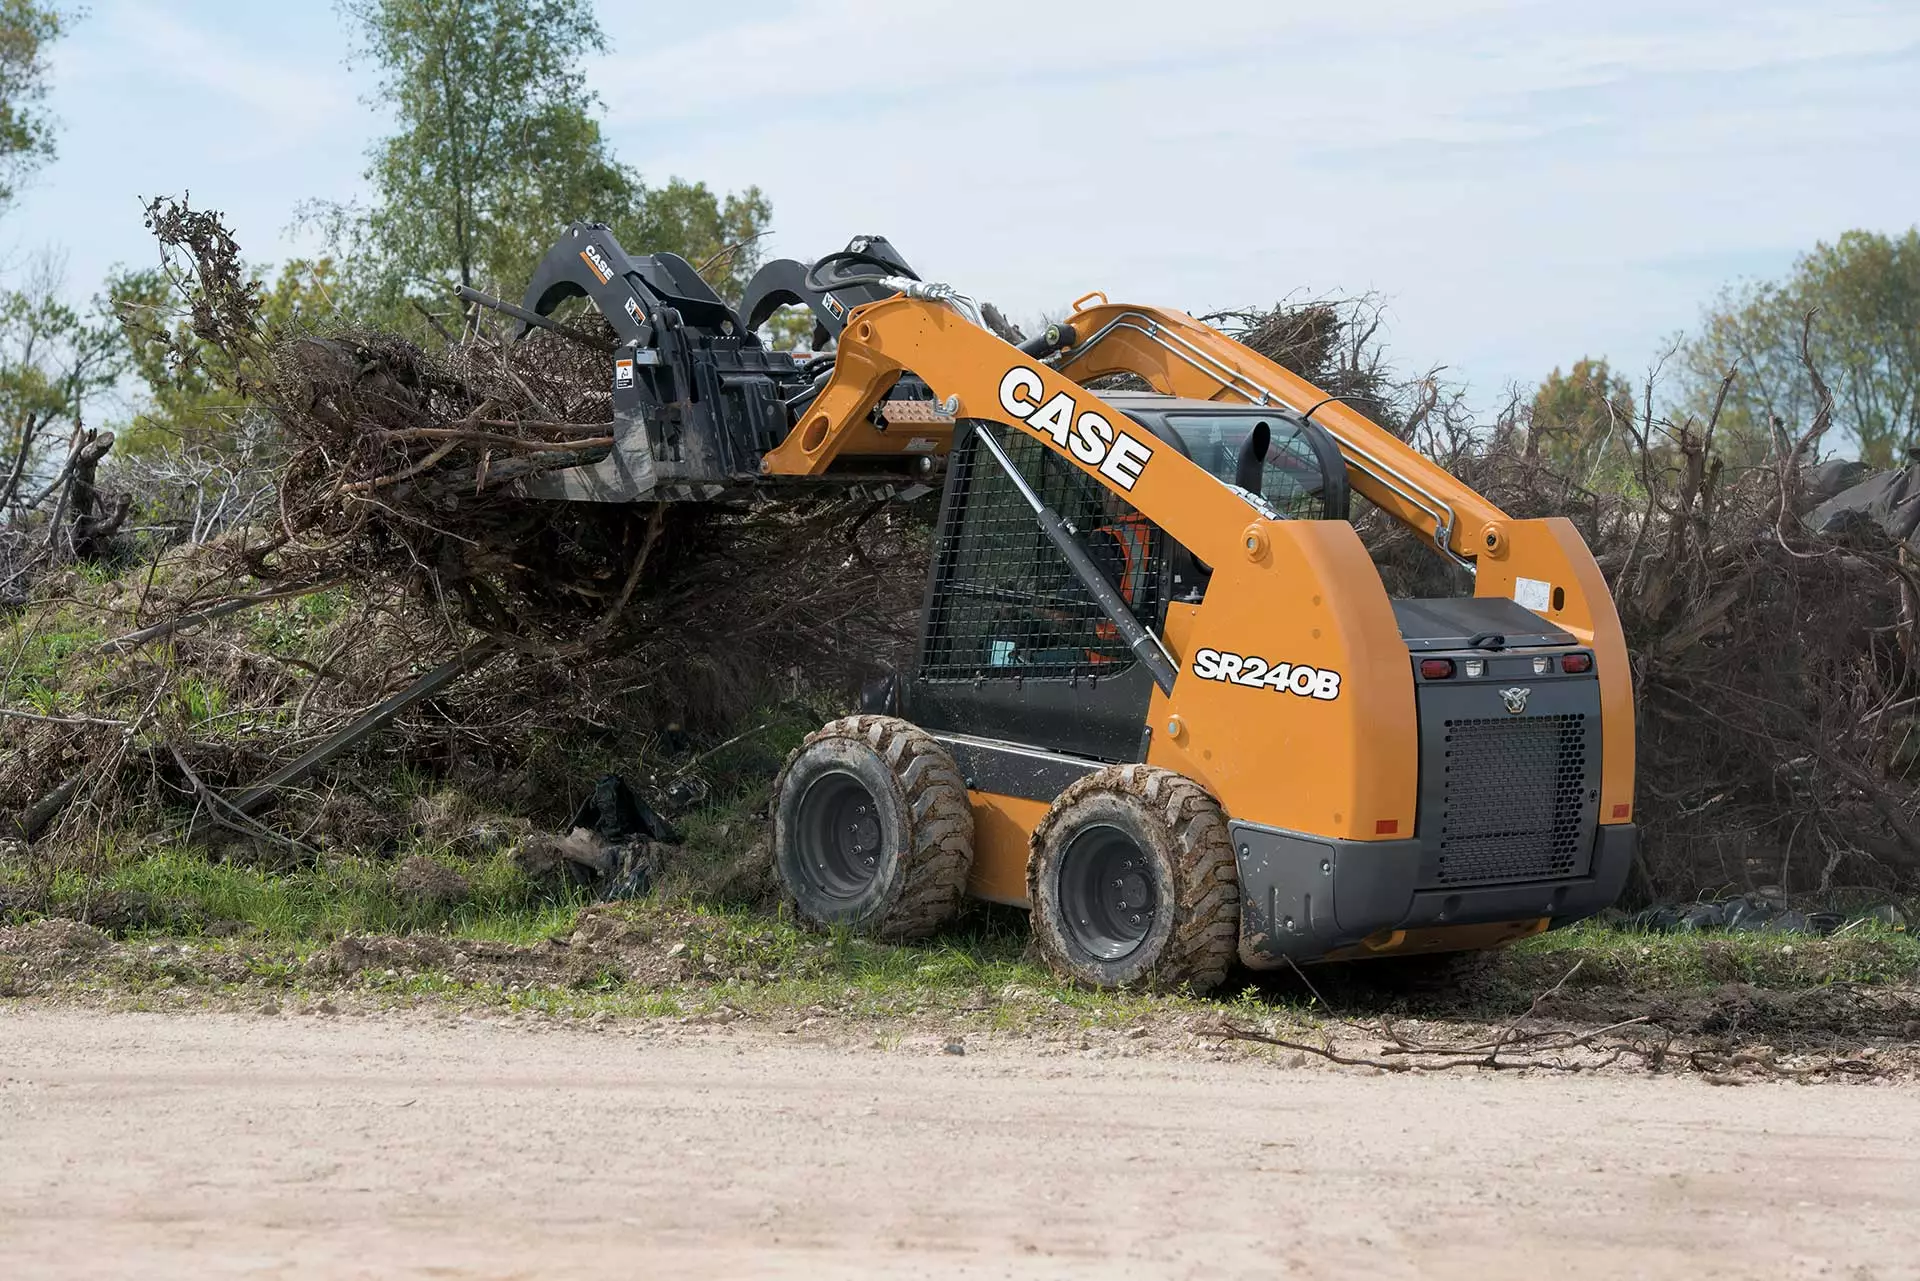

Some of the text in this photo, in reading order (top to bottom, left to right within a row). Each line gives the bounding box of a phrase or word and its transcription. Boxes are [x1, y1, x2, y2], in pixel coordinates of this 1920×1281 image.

[585, 245, 614, 280] CASE
[999, 365, 1154, 492] CASE
[1193, 648, 1341, 700] SR240B
